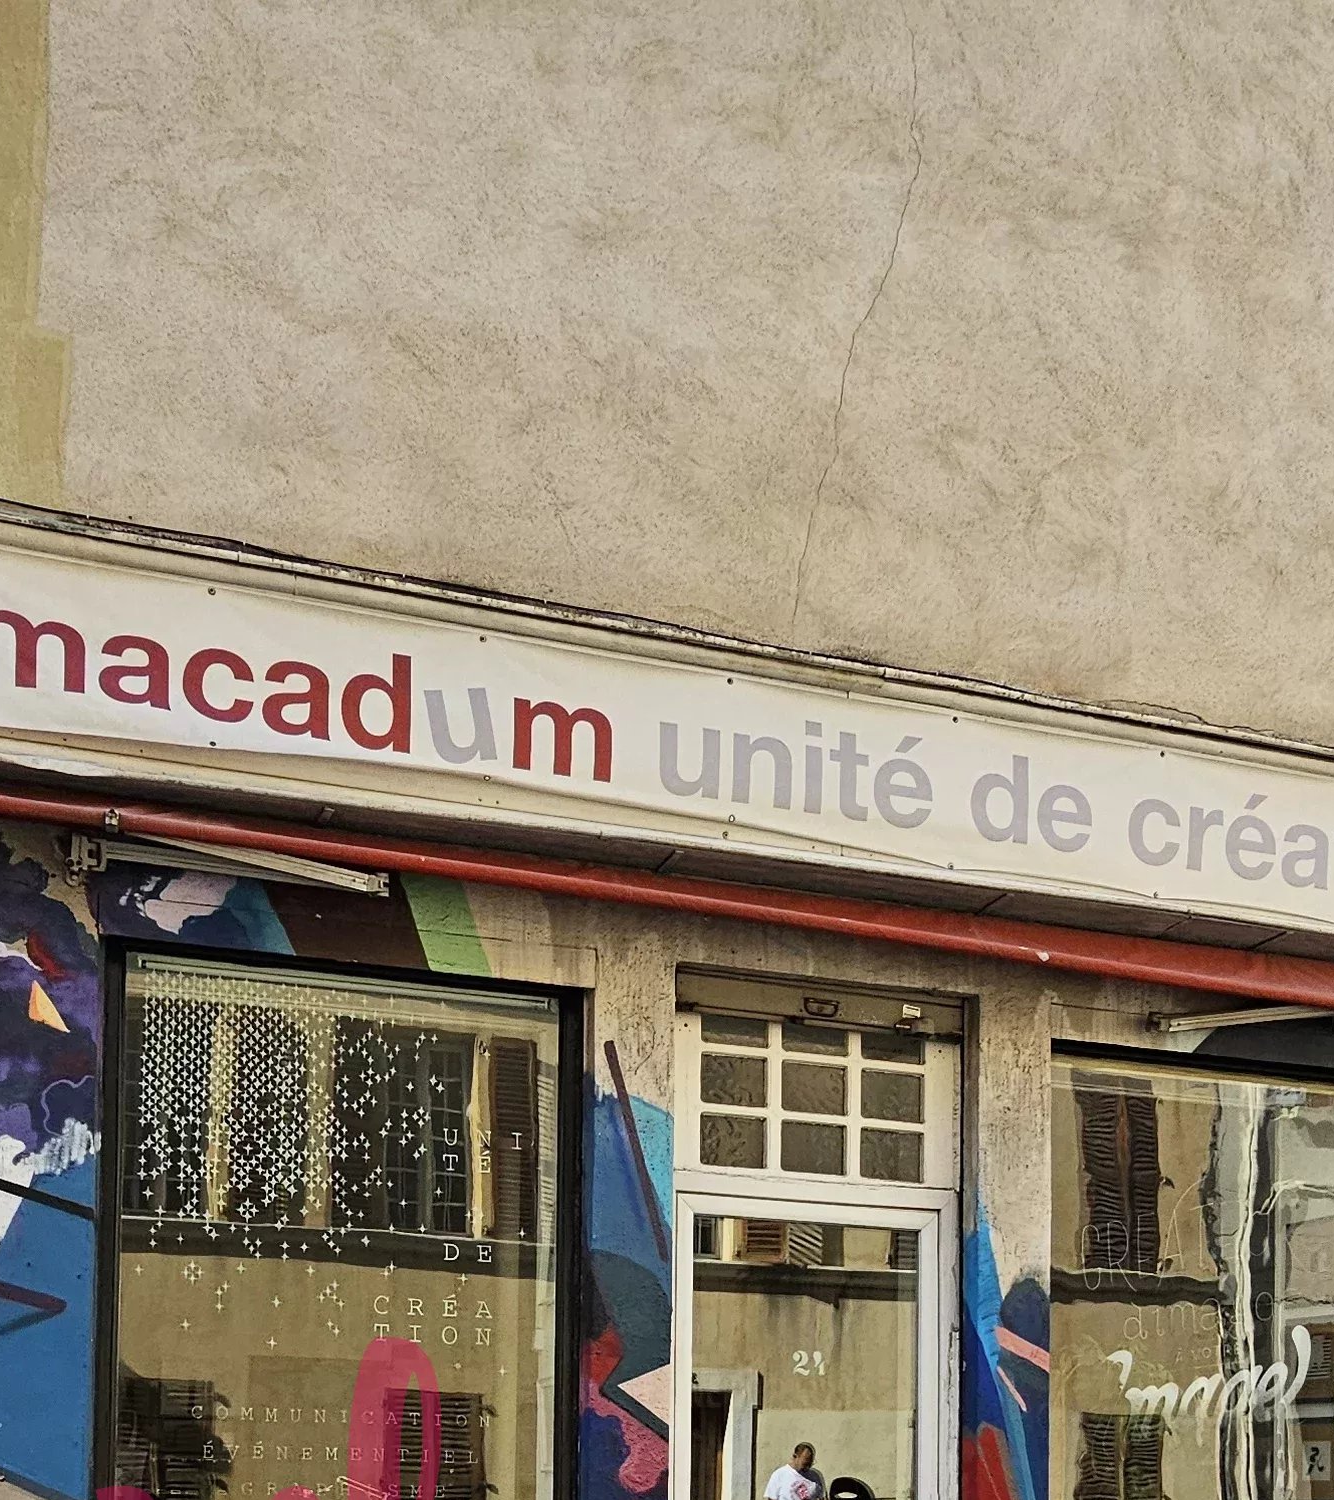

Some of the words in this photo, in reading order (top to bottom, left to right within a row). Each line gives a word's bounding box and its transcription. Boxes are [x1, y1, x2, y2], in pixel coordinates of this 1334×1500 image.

[658, 720, 933, 829] unité
[971, 755, 1093, 853] de
[442, 1242, 493, 1264] DE
[190, 1404, 491, 1428] COMMUNICATION
[240, 1481, 447, 1499] GRAPHSME
